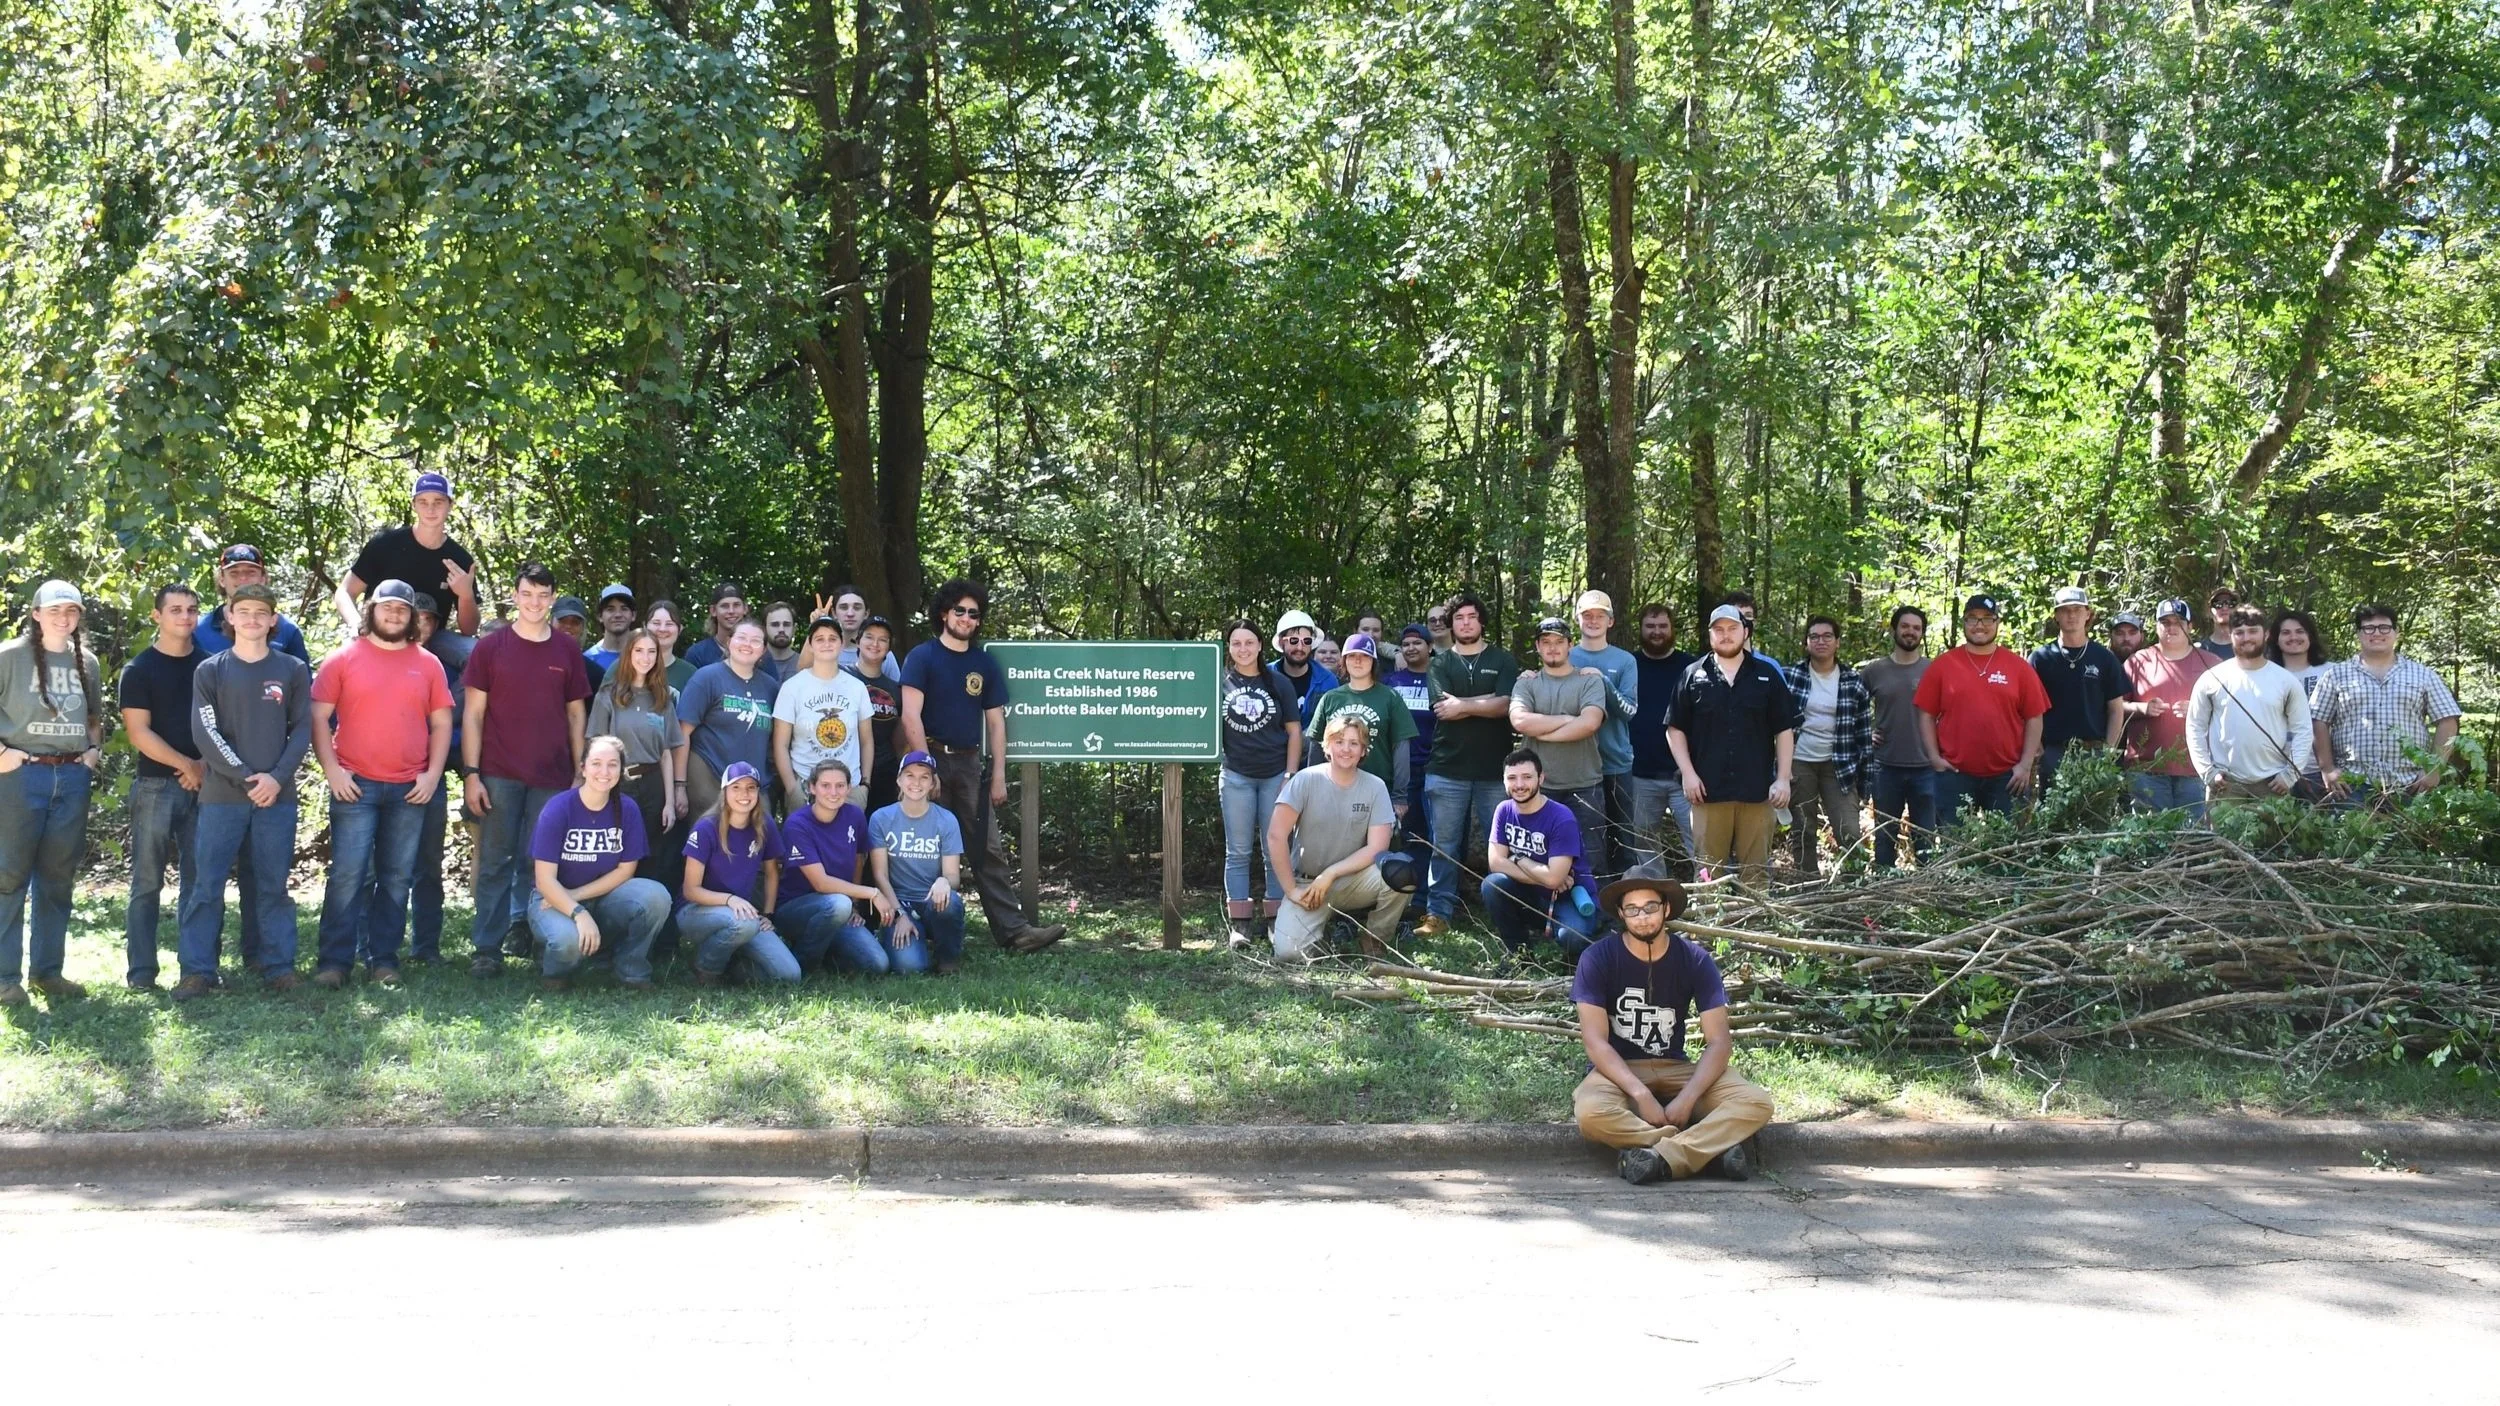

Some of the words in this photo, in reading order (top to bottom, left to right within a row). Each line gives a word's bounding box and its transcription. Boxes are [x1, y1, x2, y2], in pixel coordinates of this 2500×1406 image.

[1008, 667, 1051, 680] Banita
[1053, 667, 1092, 680] Creek
[1095, 667, 1140, 680] Nature
[1143, 667, 1195, 680] Reserve
[1045, 685, 1122, 698] Established
[1125, 686, 1158, 698] 1986
[804, 692, 834, 711] SEGUIN
[836, 694, 851, 710] FFA
[1014, 703, 1077, 716] Charlotte
[1080, 703, 1118, 716] Baker
[1121, 703, 1207, 719] Montgomery
[32, 723, 85, 735] TENNIS
[1114, 741, 1208, 749] www.texaslandconservancy.org
[564, 829, 609, 852] SFA
[900, 831, 941, 853] East
[561, 853, 598, 862] NURSING
[899, 852, 940, 860] FOUNDATIO
[1616, 993, 1671, 1051] SFA
